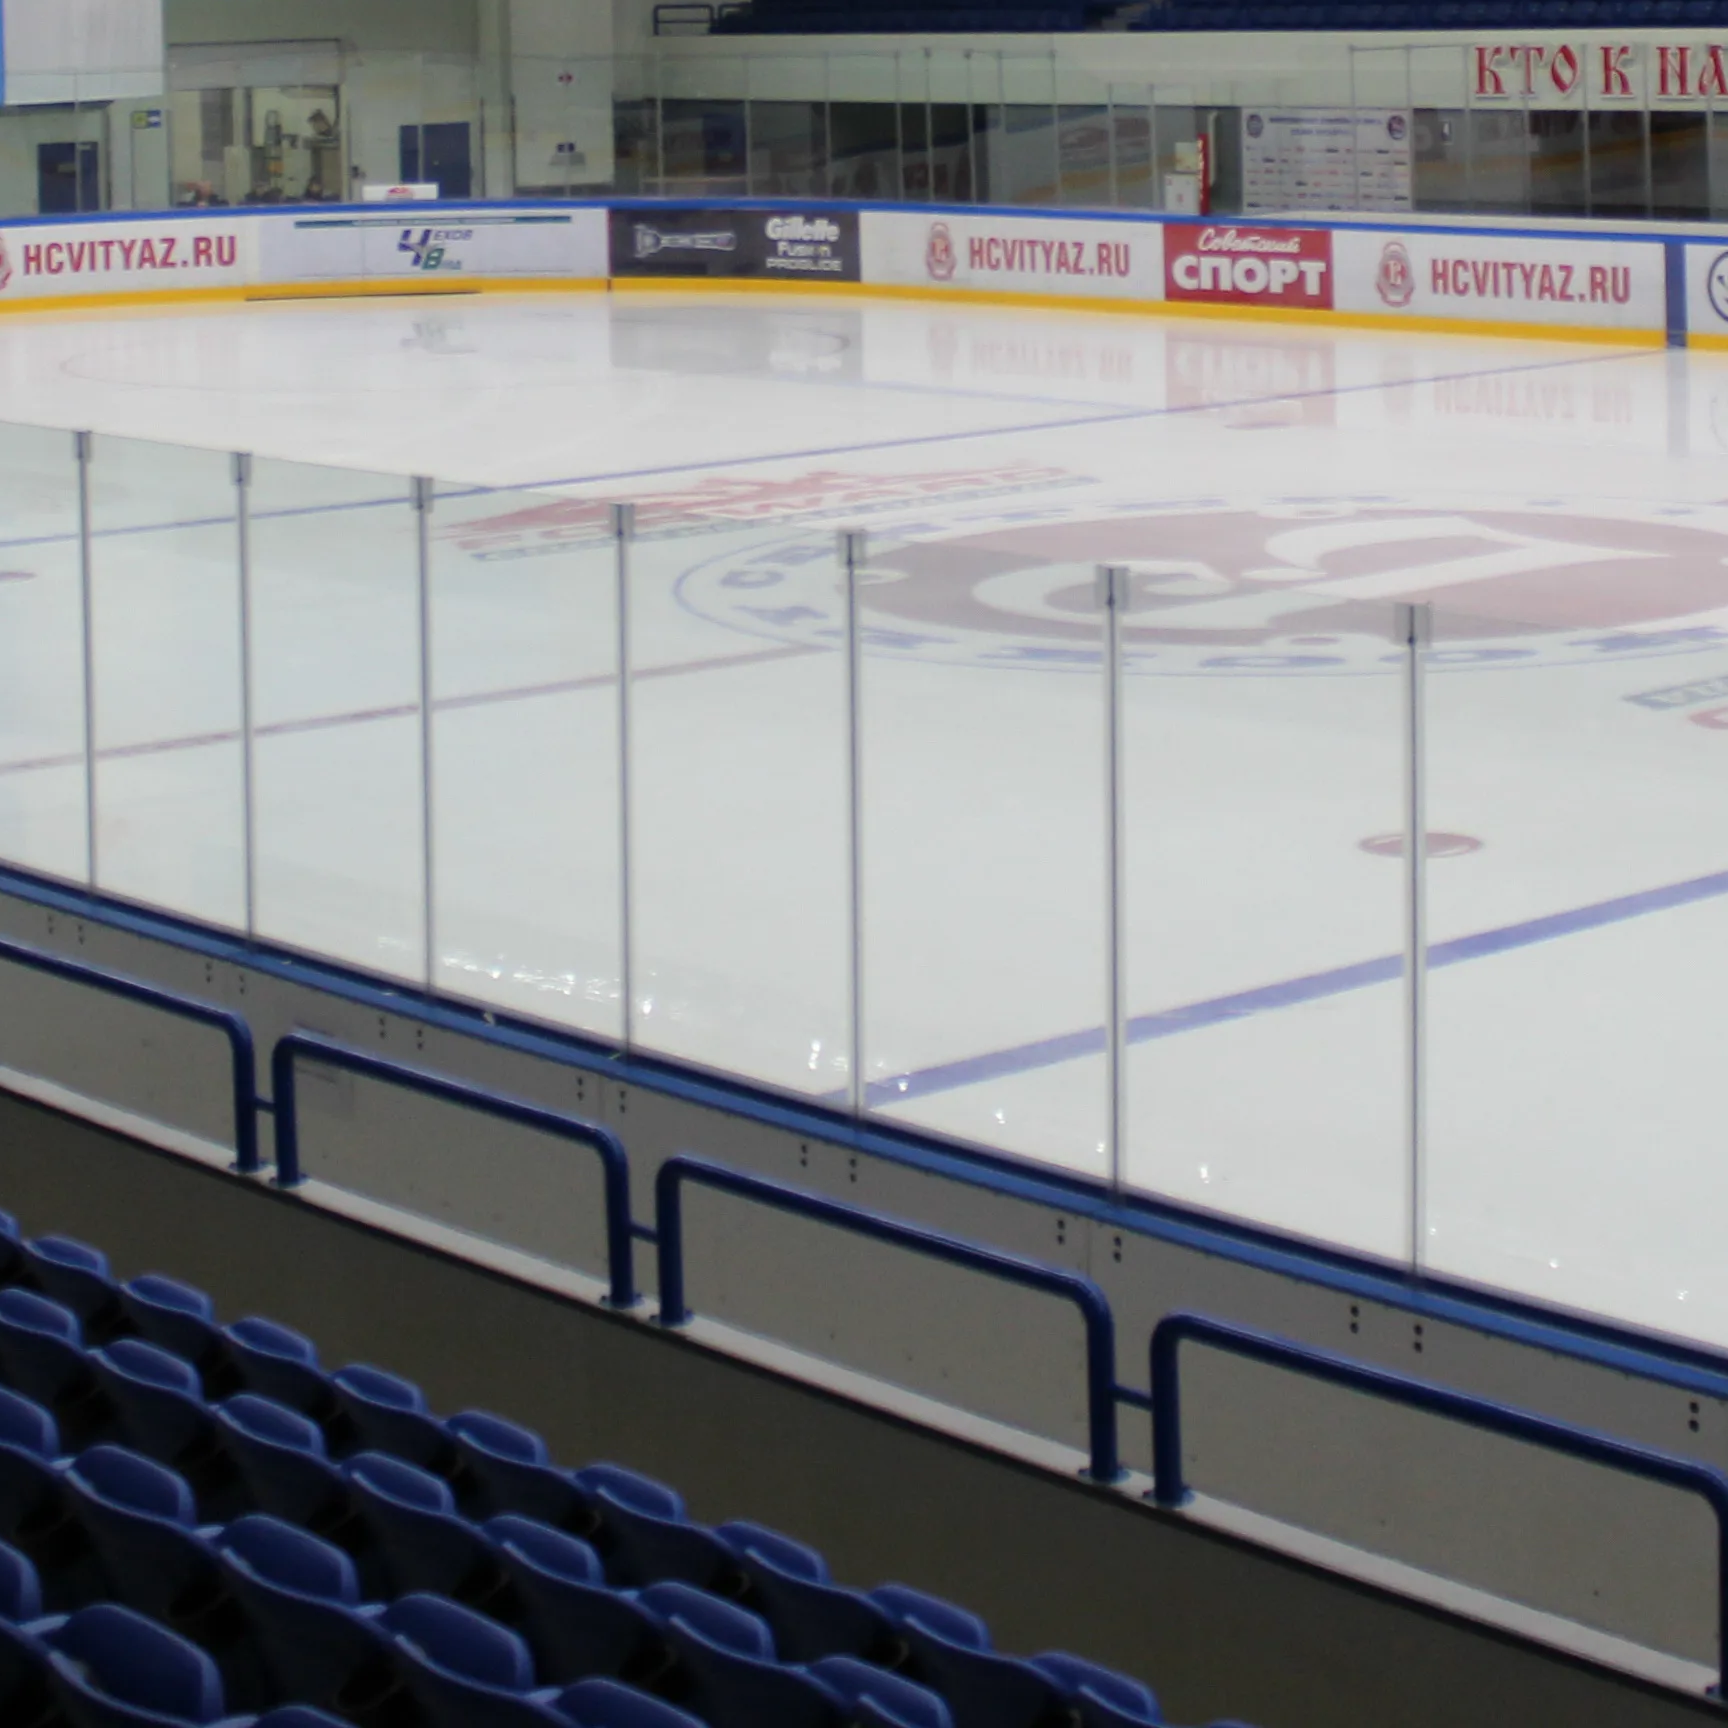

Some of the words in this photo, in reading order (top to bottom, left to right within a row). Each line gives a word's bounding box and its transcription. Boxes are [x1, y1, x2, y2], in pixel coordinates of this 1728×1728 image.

[1474, 43, 1581, 97] КТО
[1599, 45, 1634, 97] К
[765, 215, 841, 243] Gillette
[1196, 228, 1302, 254] Советский
[23, 235, 237, 276] HCVITYAZ.RU
[968, 237, 1131, 278] HCVITYAZ.RU
[1172, 255, 1328, 296] СПОРТ
[1431, 258, 1632, 305] HCVITYAZ.RU
